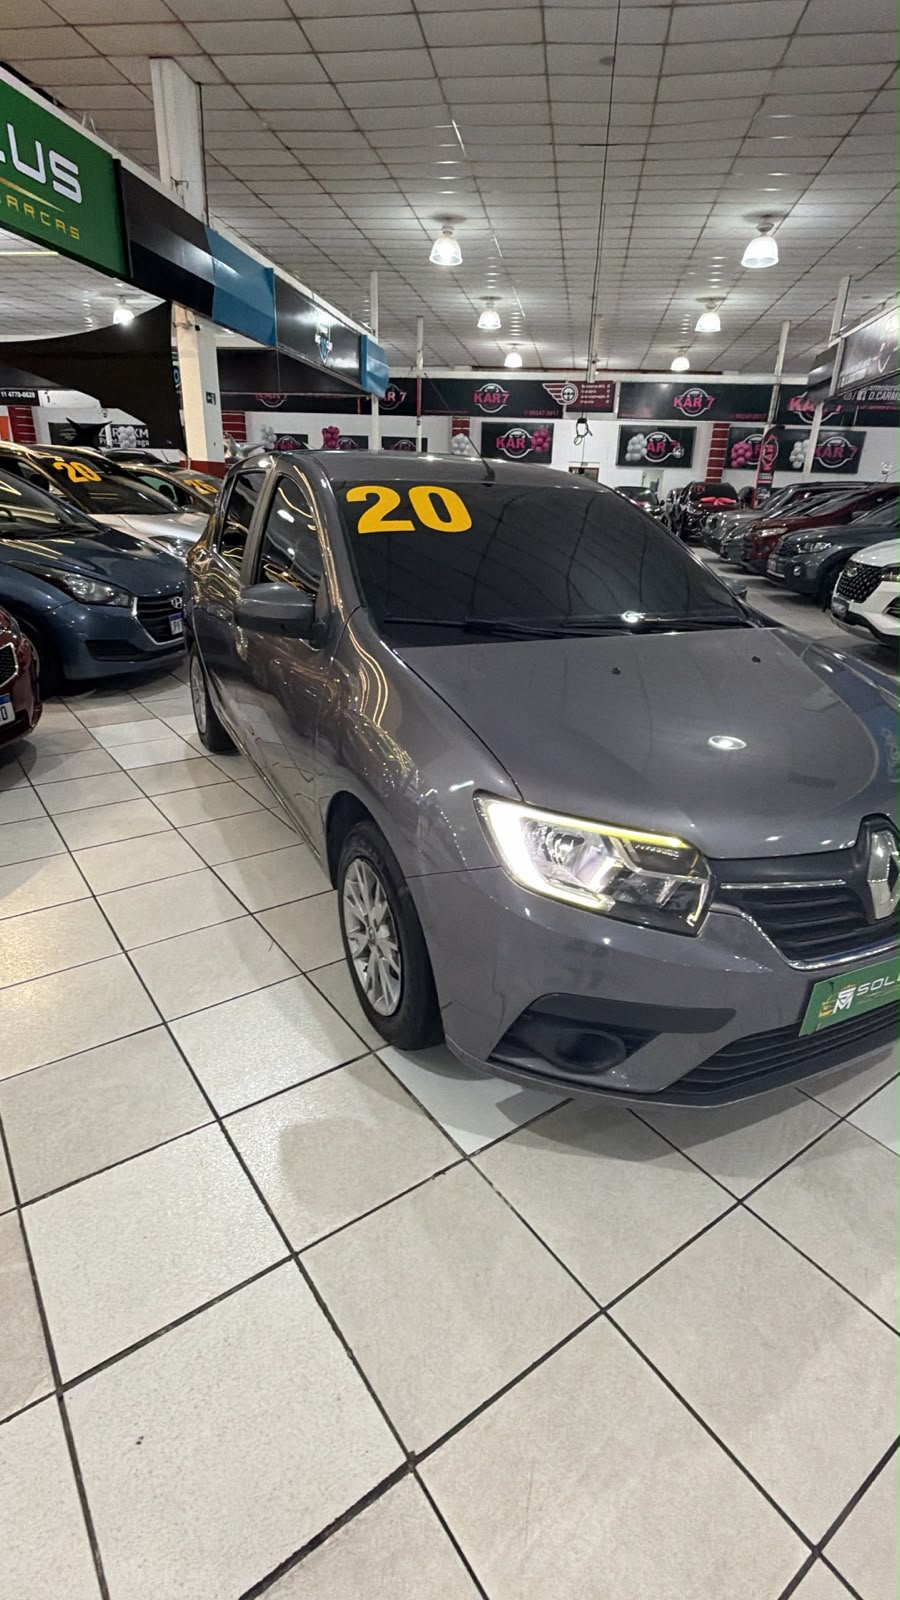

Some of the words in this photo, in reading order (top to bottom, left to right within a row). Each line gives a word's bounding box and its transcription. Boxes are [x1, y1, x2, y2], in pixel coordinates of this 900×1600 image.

[0, 193, 80, 240] ARCAS
[646, 441, 666, 453] AR
[52, 460, 102, 484] 20
[345, 485, 473, 534] 20
